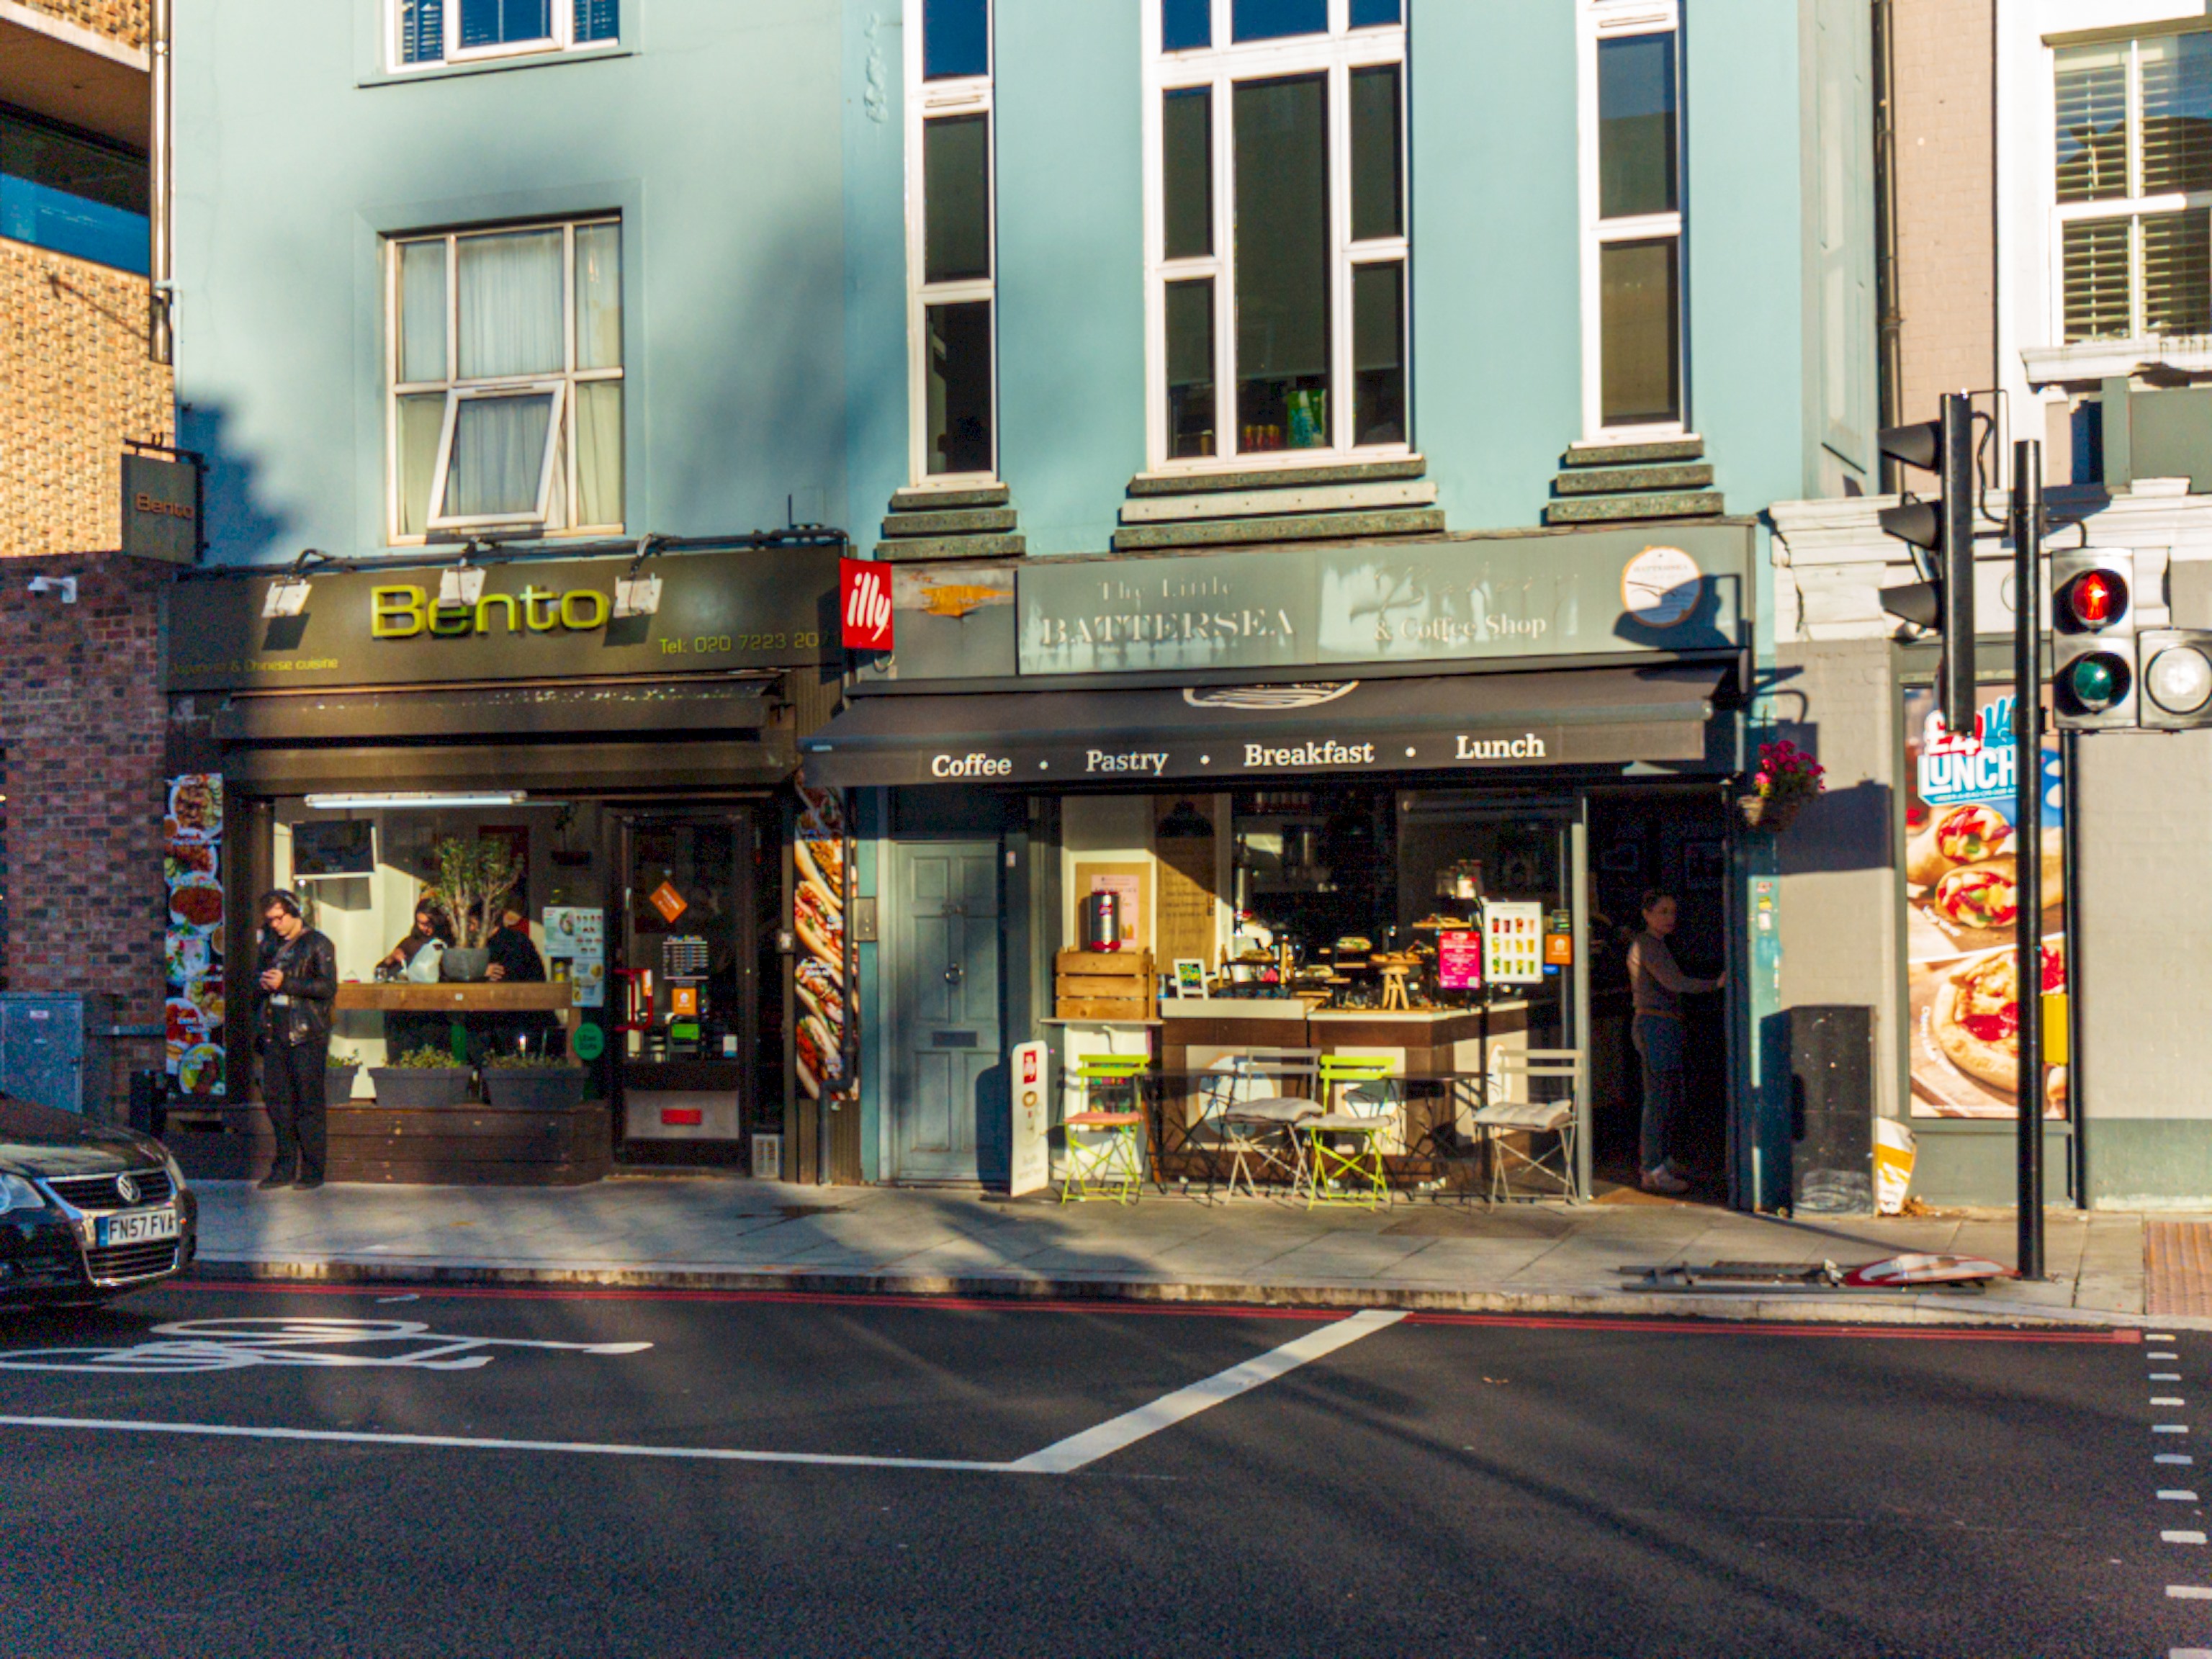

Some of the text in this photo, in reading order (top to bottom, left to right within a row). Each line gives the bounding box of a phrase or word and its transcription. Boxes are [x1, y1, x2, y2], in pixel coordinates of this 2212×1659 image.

[135, 492, 194, 519] Bento
[1096, 576, 1233, 601] The Little
[370, 583, 609, 638] Bento
[847, 572, 891, 642] illy
[1041, 608, 1294, 645] BATTERSEA
[1400, 615, 1477, 640] Coffee
[1485, 613, 1547, 639] Shop
[693, 635, 732, 653] 020
[738, 632, 787, 649] 7223
[295, 656, 339, 670] cuisine
[932, 732, 1546, 777] Coffee Pastry Breakfast Lunch
[1920, 745, 2018, 797] LUNCH
[109, 1215, 147, 1241] FN57
